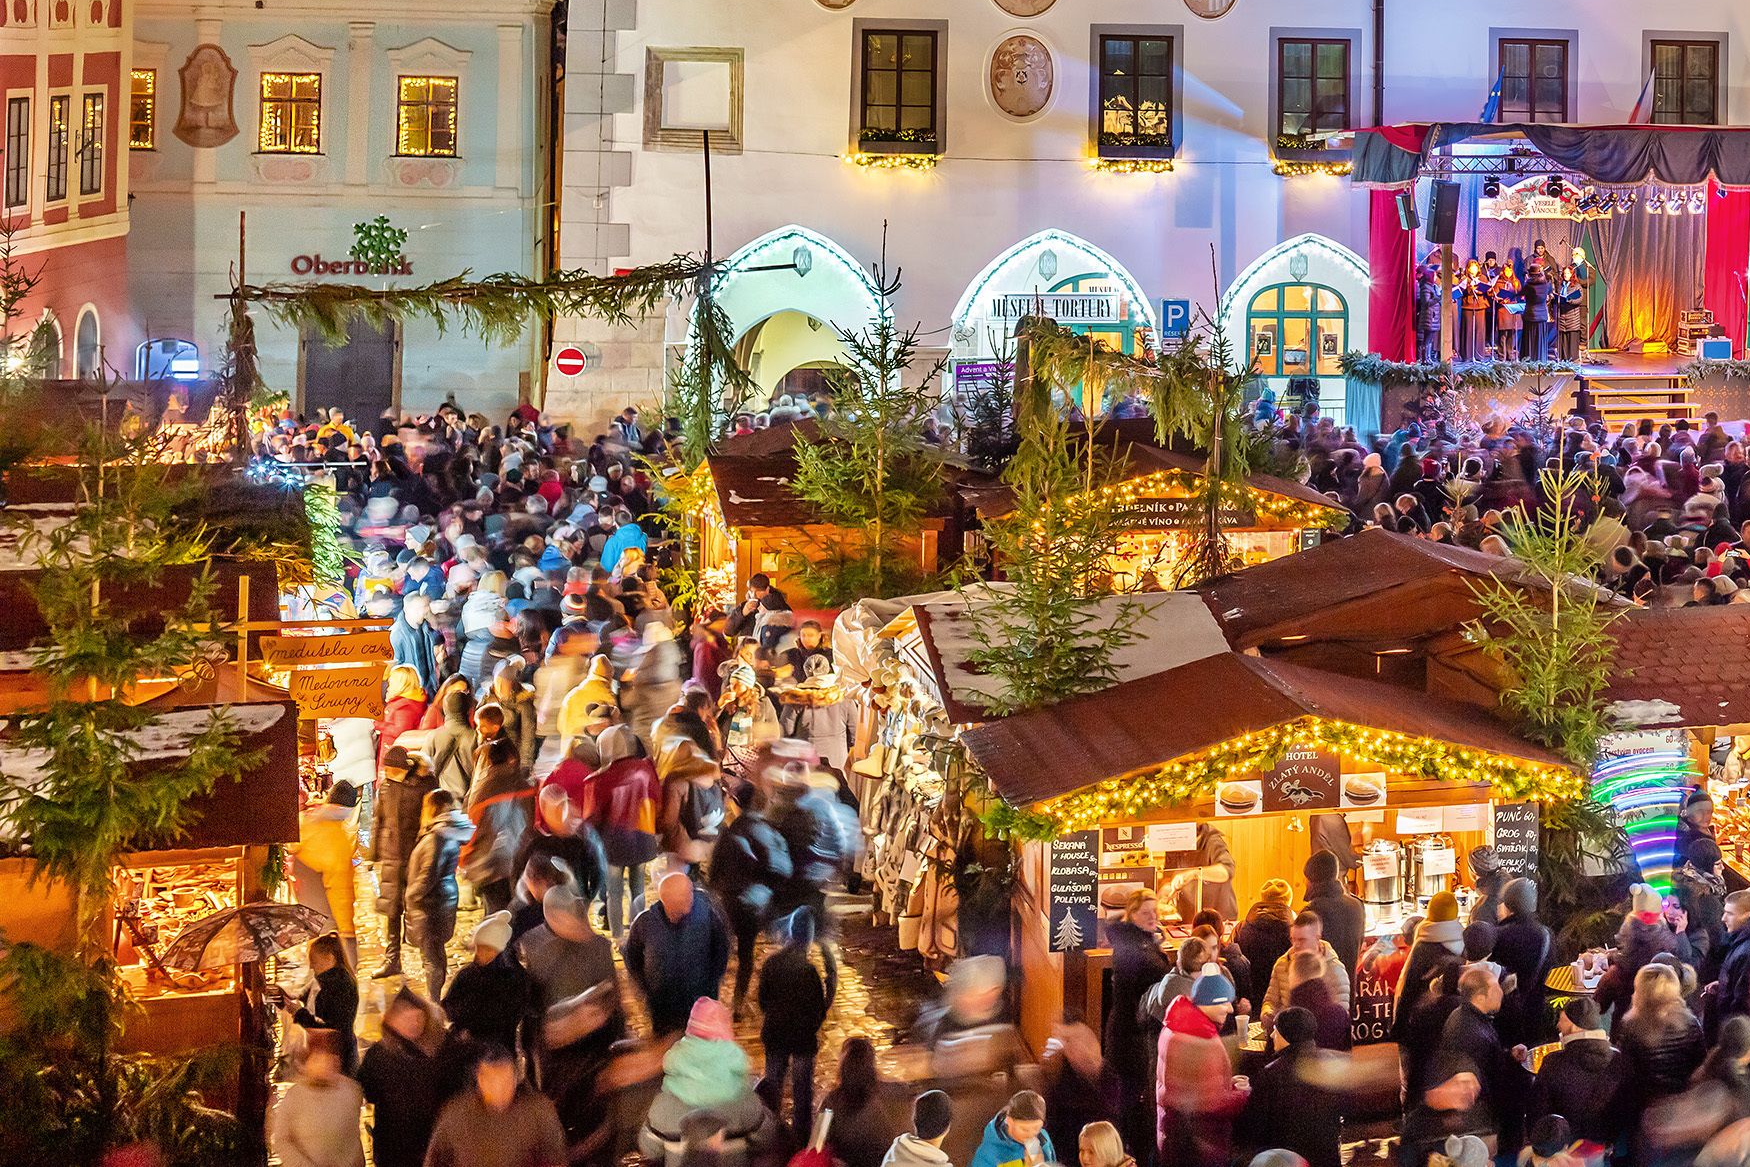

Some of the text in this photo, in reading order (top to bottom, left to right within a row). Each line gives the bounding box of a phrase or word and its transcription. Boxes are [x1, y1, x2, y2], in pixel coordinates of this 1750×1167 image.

[290, 254, 414, 275] Oberbnk
[1053, 299, 1112, 318] TORTURY
[1168, 305, 1184, 327] P
[1149, 514, 1172, 525] VÍNO
[300, 675, 378, 691] Medovina
[310, 693, 367, 714] Sirupy
[1286, 752, 1318, 761] HOTEL
[1269, 764, 1300, 790] ZLATÝ
[1496, 806, 1522, 823] PUNČ
[1053, 835, 1087, 850] SEKANÁ
[1052, 863, 1090, 875] KLOBÁSA
[1054, 893, 1091, 904] POLÉVKA
[1350, 1023, 1384, 1041] ROG
